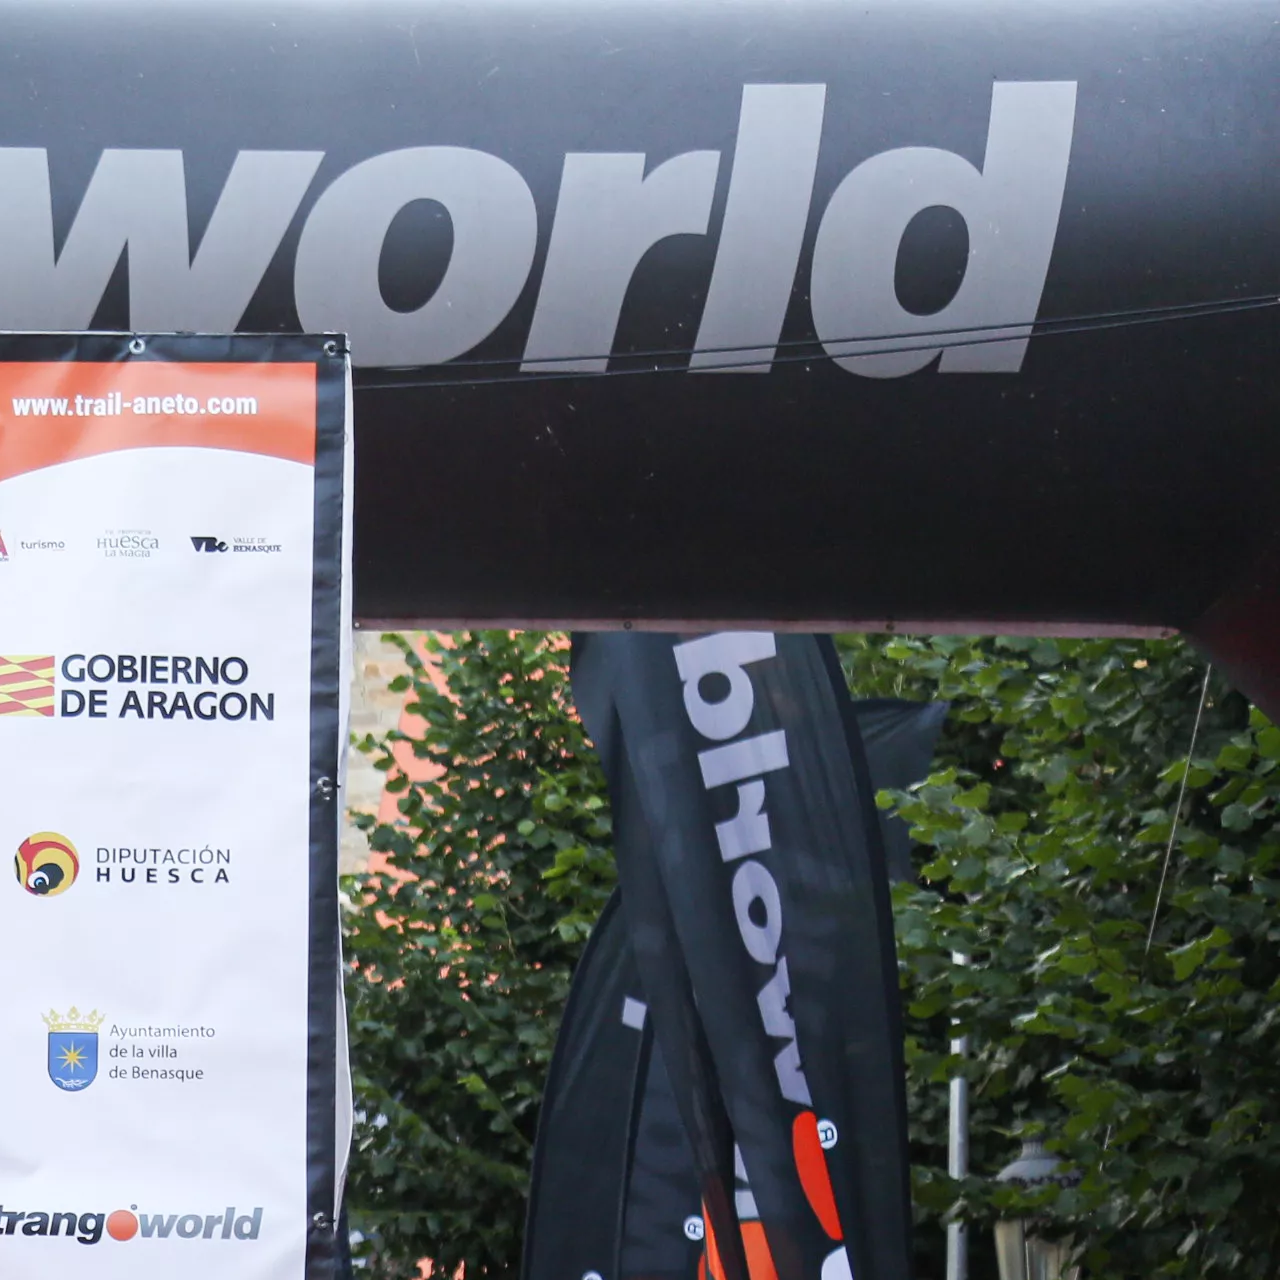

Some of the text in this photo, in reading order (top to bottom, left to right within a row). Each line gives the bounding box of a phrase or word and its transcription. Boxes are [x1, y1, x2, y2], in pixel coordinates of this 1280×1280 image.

[13, 393, 257, 417] www.trail-aneto.com
[21, 540, 66, 550] turismo
[233, 544, 282, 553] BENASQUE
[61, 654, 249, 685] GOBIERNO
[61, 690, 275, 721] DE ARAGON
[96, 844, 232, 864] DIPUTACIÓN
[96, 868, 231, 883] HUESCA
[110, 1024, 215, 1040] Ayuntamiento
[109, 1045, 178, 1058] de la villa
[109, 1066, 204, 1083] de Benasque
